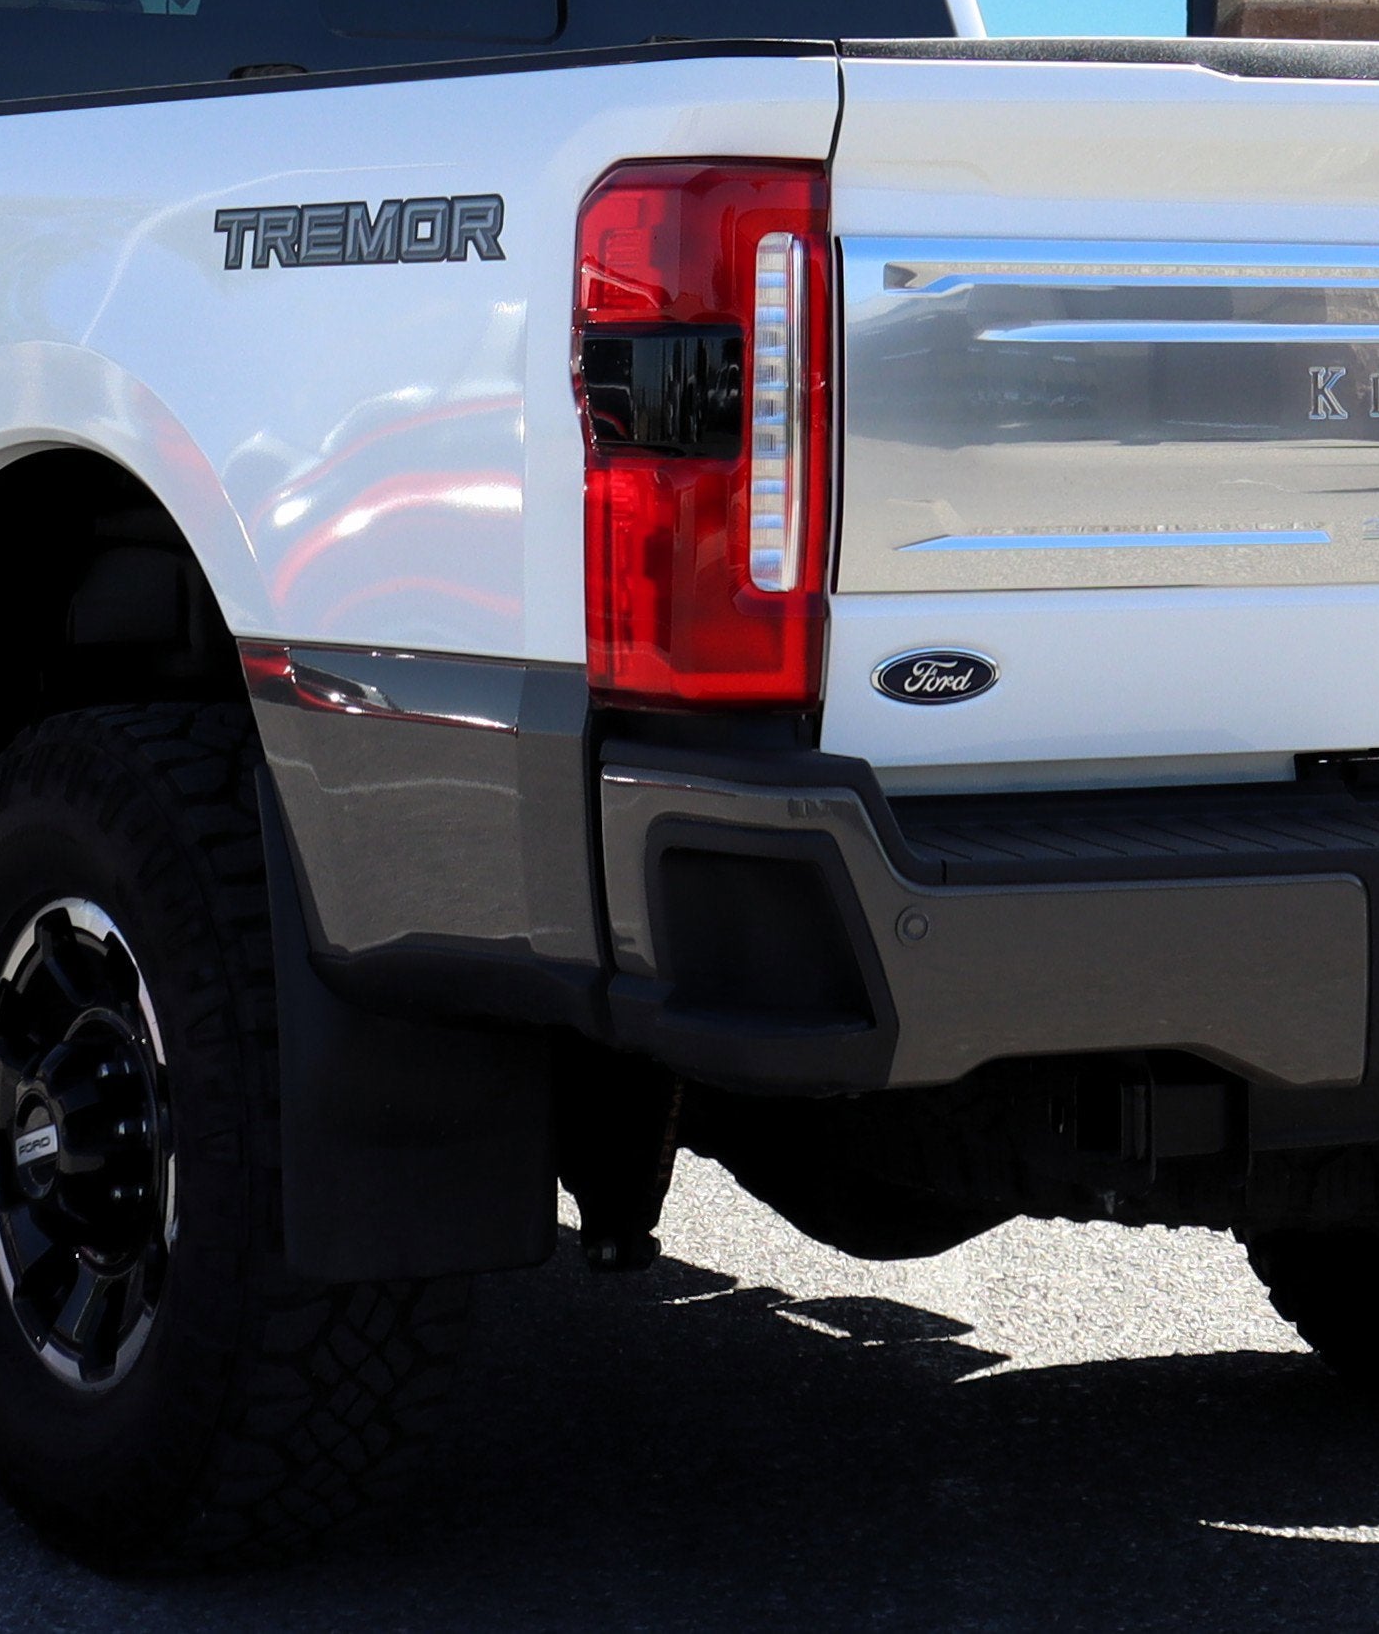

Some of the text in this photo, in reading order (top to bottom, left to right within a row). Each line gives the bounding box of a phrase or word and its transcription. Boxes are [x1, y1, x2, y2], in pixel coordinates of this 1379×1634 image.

[214, 193, 506, 270] TREMOR
[904, 660, 974, 692] Ford
[18, 1136, 51, 1155] FORD
